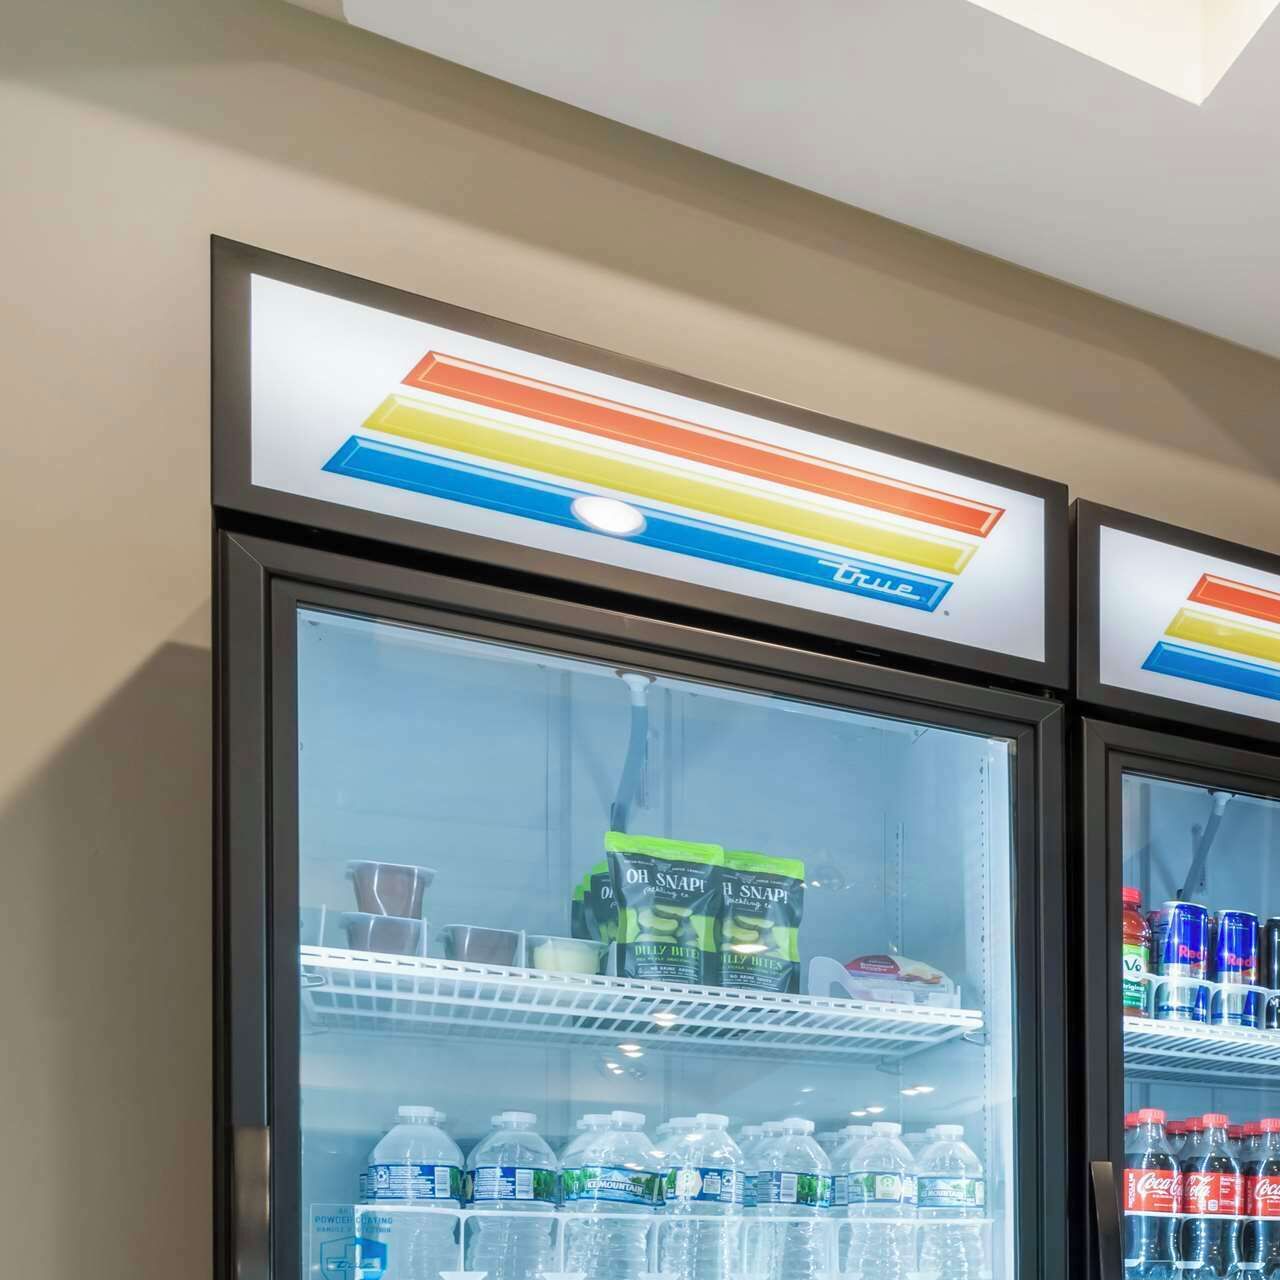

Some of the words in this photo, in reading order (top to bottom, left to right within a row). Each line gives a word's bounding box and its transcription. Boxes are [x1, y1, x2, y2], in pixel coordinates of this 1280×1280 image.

[626, 869, 649, 884] OH
[656, 872, 705, 893] SNAP!
[740, 885, 788, 904] SNAP!
[635, 945, 665, 957] DILLY
[602, 1180, 644, 1194] MOUNTAIN
